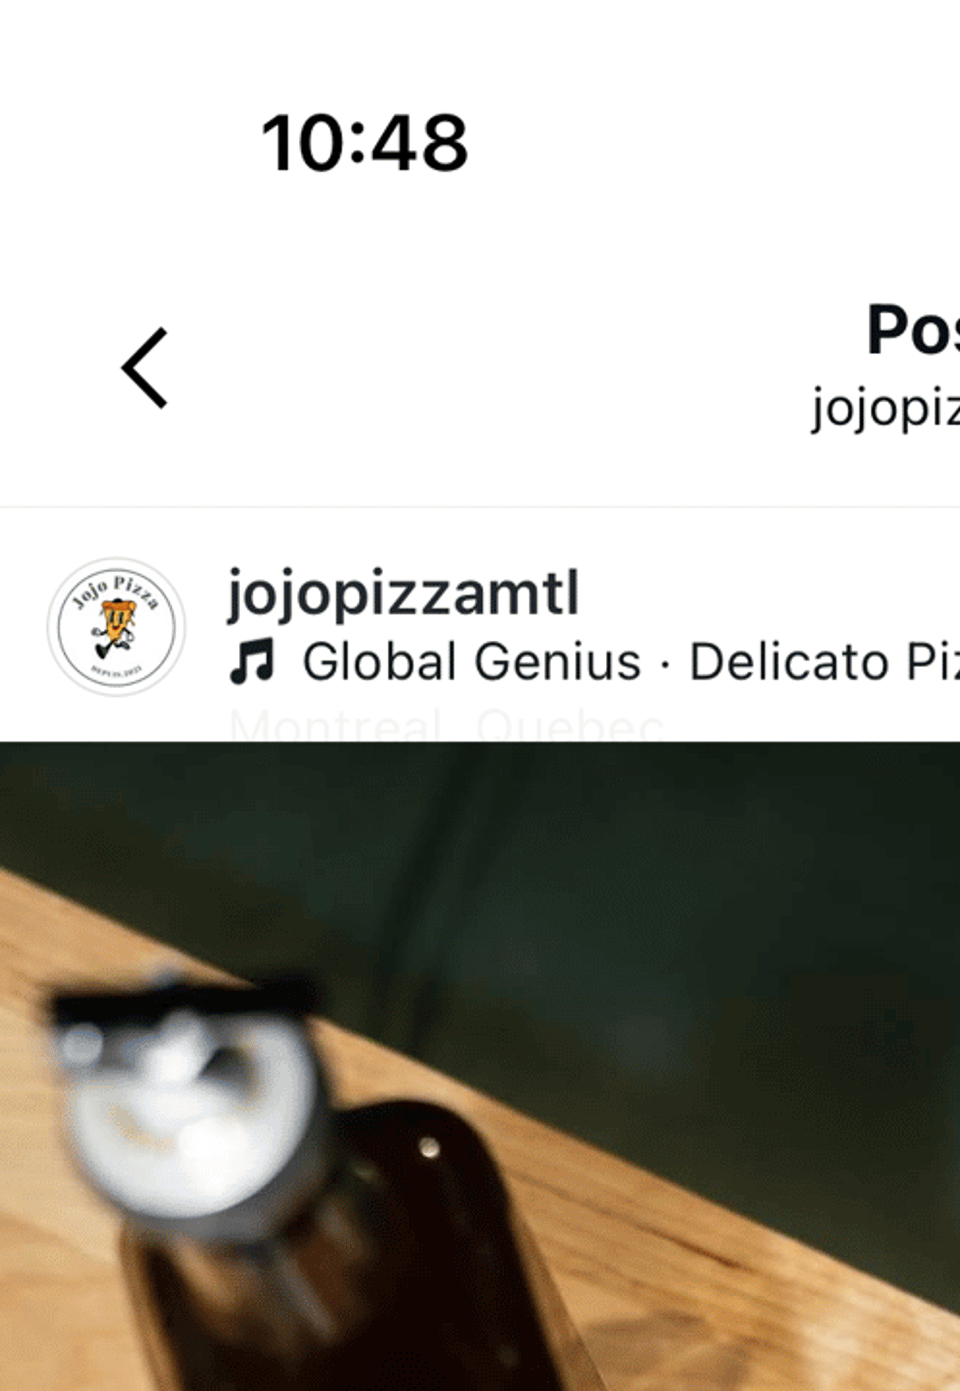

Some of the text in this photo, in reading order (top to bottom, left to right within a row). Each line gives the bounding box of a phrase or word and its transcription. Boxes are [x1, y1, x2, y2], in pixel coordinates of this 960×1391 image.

[263, 113, 468, 172] 10:48
[73, 575, 158, 610] Jojo Pizza
[226, 567, 578, 626] jojopizzamtl
[304, 639, 454, 682] Global
[475, 639, 641, 682] Genius
[692, 639, 889, 682] Delicato
